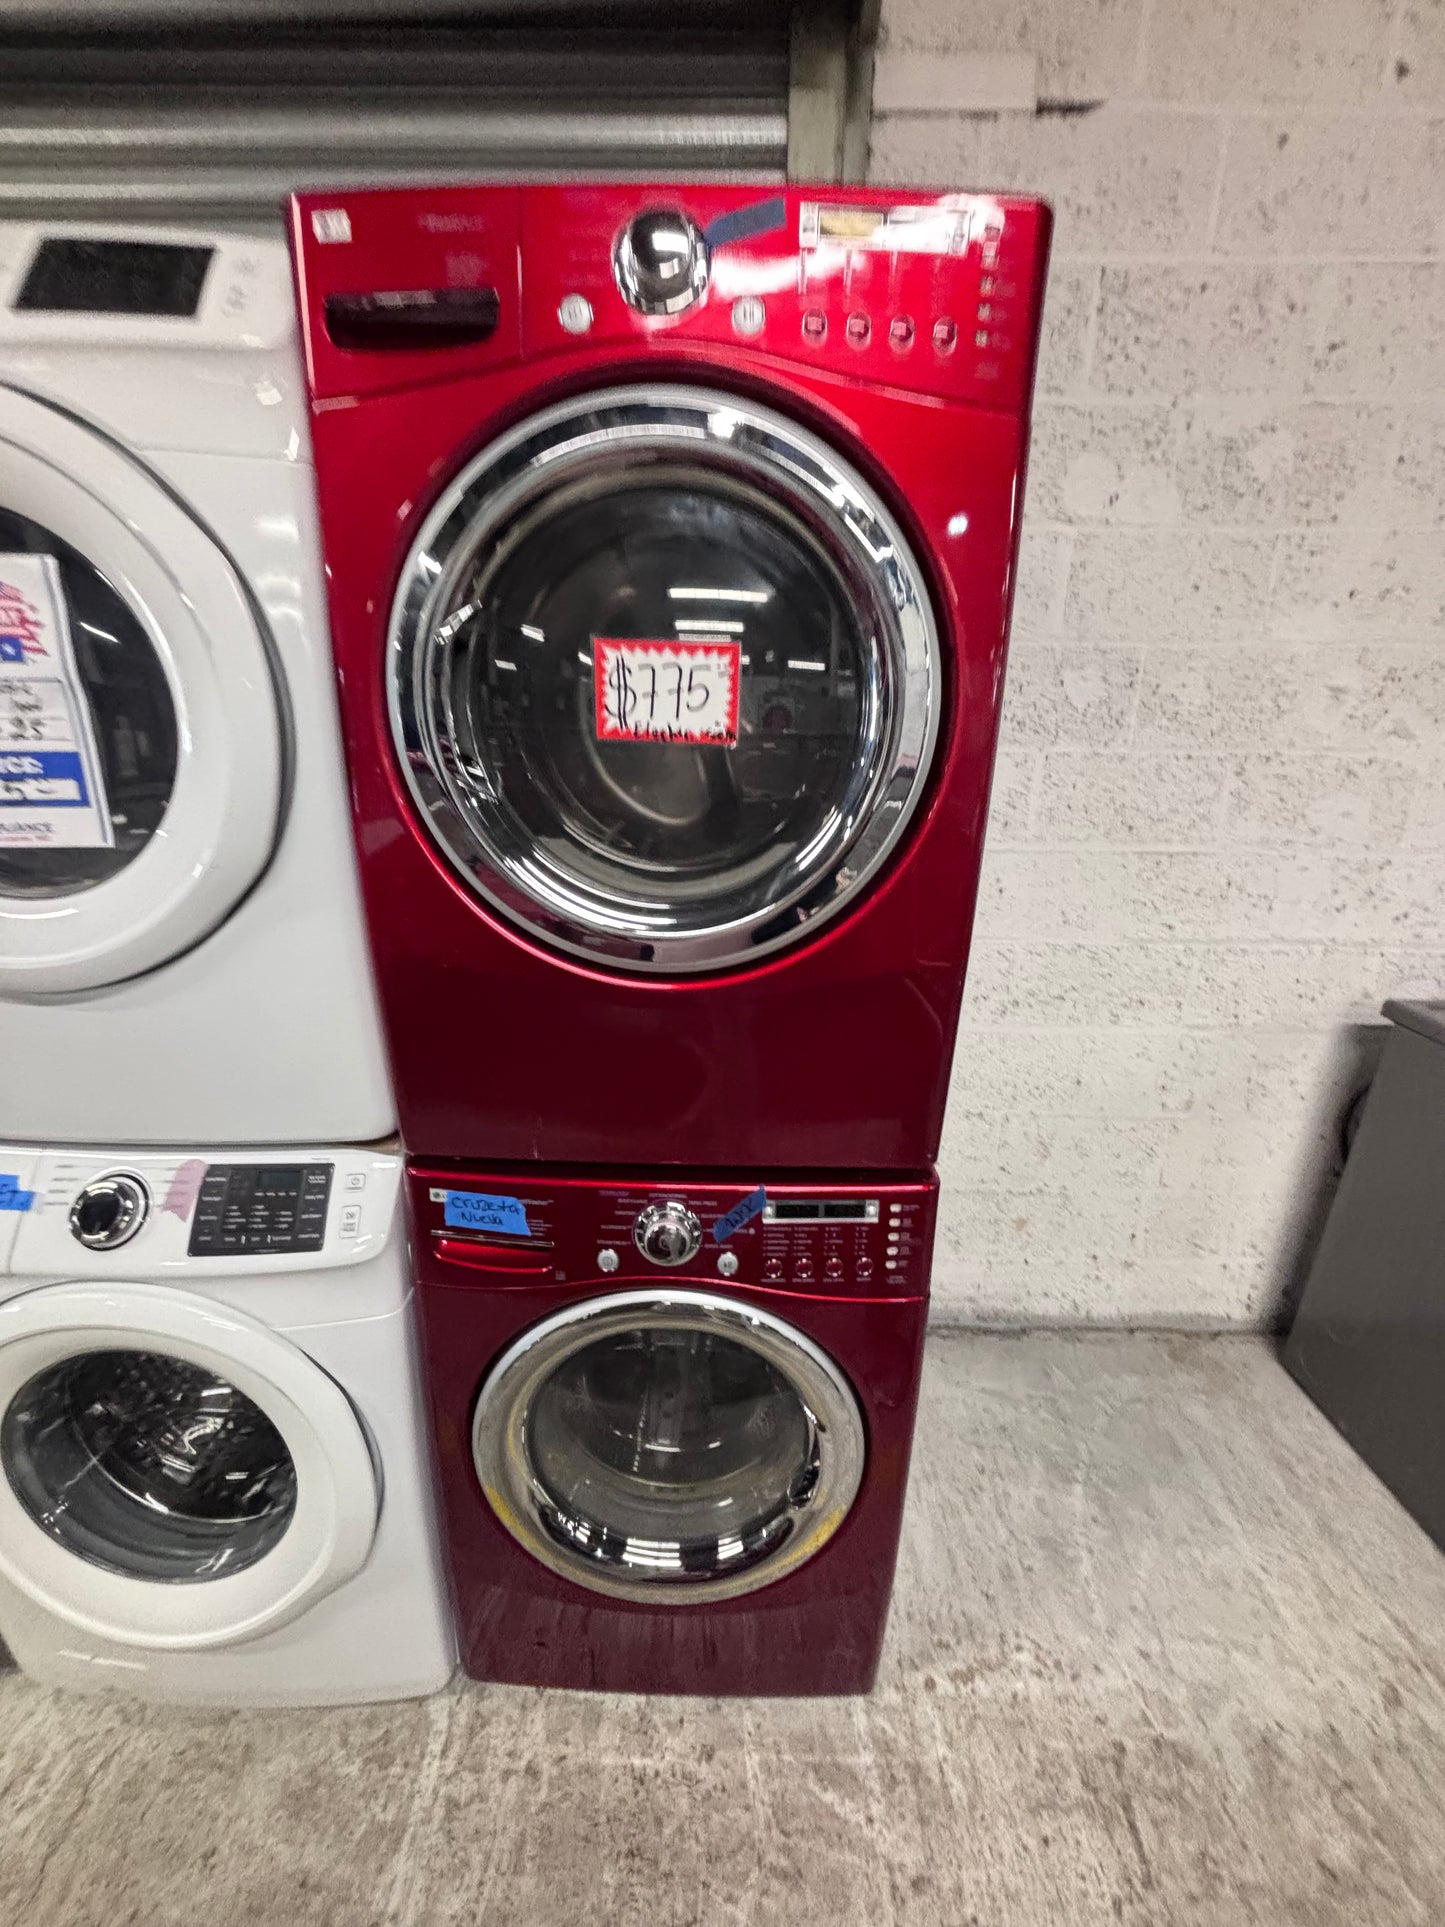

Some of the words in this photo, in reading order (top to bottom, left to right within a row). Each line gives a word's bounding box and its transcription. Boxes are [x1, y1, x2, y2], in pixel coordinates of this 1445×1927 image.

[603, 654, 710, 730] $775
[451, 1196, 520, 1216] Cruzeta
[460, 1211, 504, 1226] Nueva
